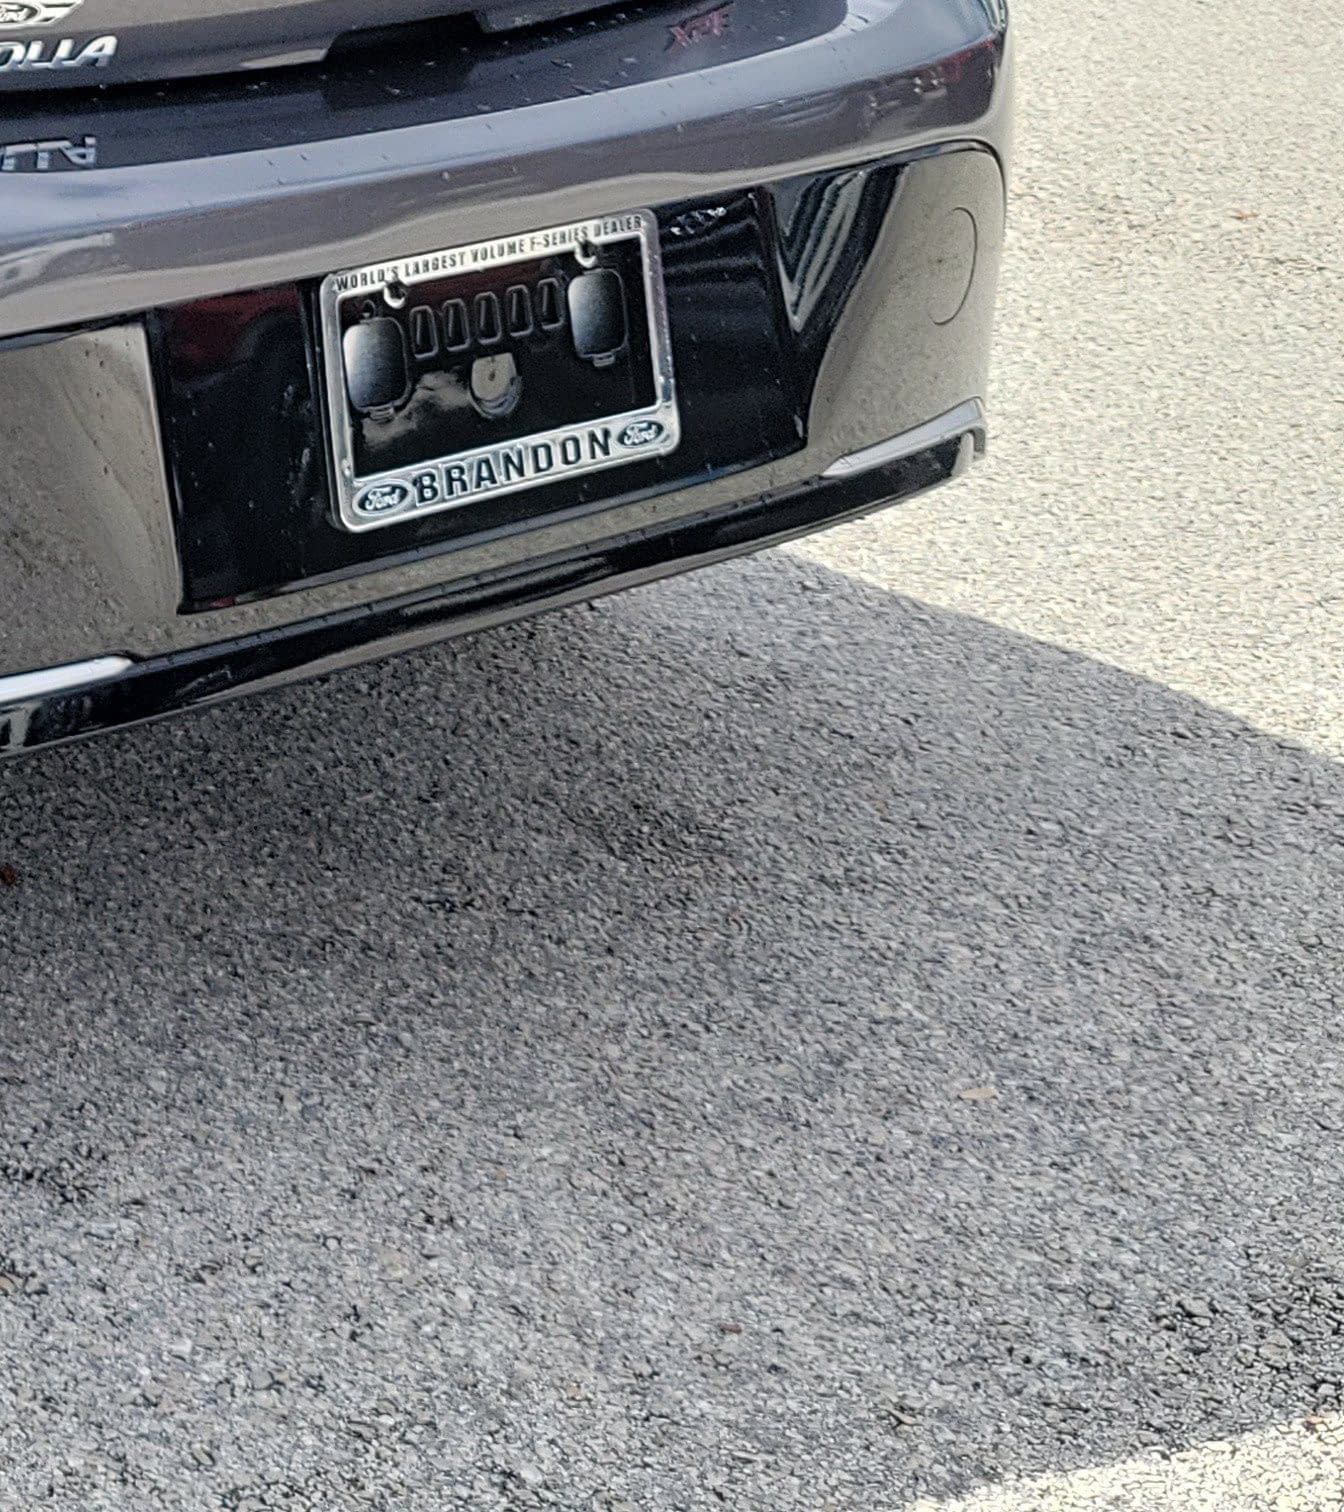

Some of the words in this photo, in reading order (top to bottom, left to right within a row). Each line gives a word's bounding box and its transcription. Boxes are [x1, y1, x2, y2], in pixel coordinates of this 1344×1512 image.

[335, 264, 400, 292] WORLD'S
[404, 251, 466, 277] LARGEST
[470, 240, 525, 264] VOLUME
[528, 226, 589, 252] F-SERIES
[593, 214, 643, 238] DEALER
[363, 485, 408, 510] Ford
[413, 426, 611, 503] BRANDON
[621, 421, 665, 446] Ford
